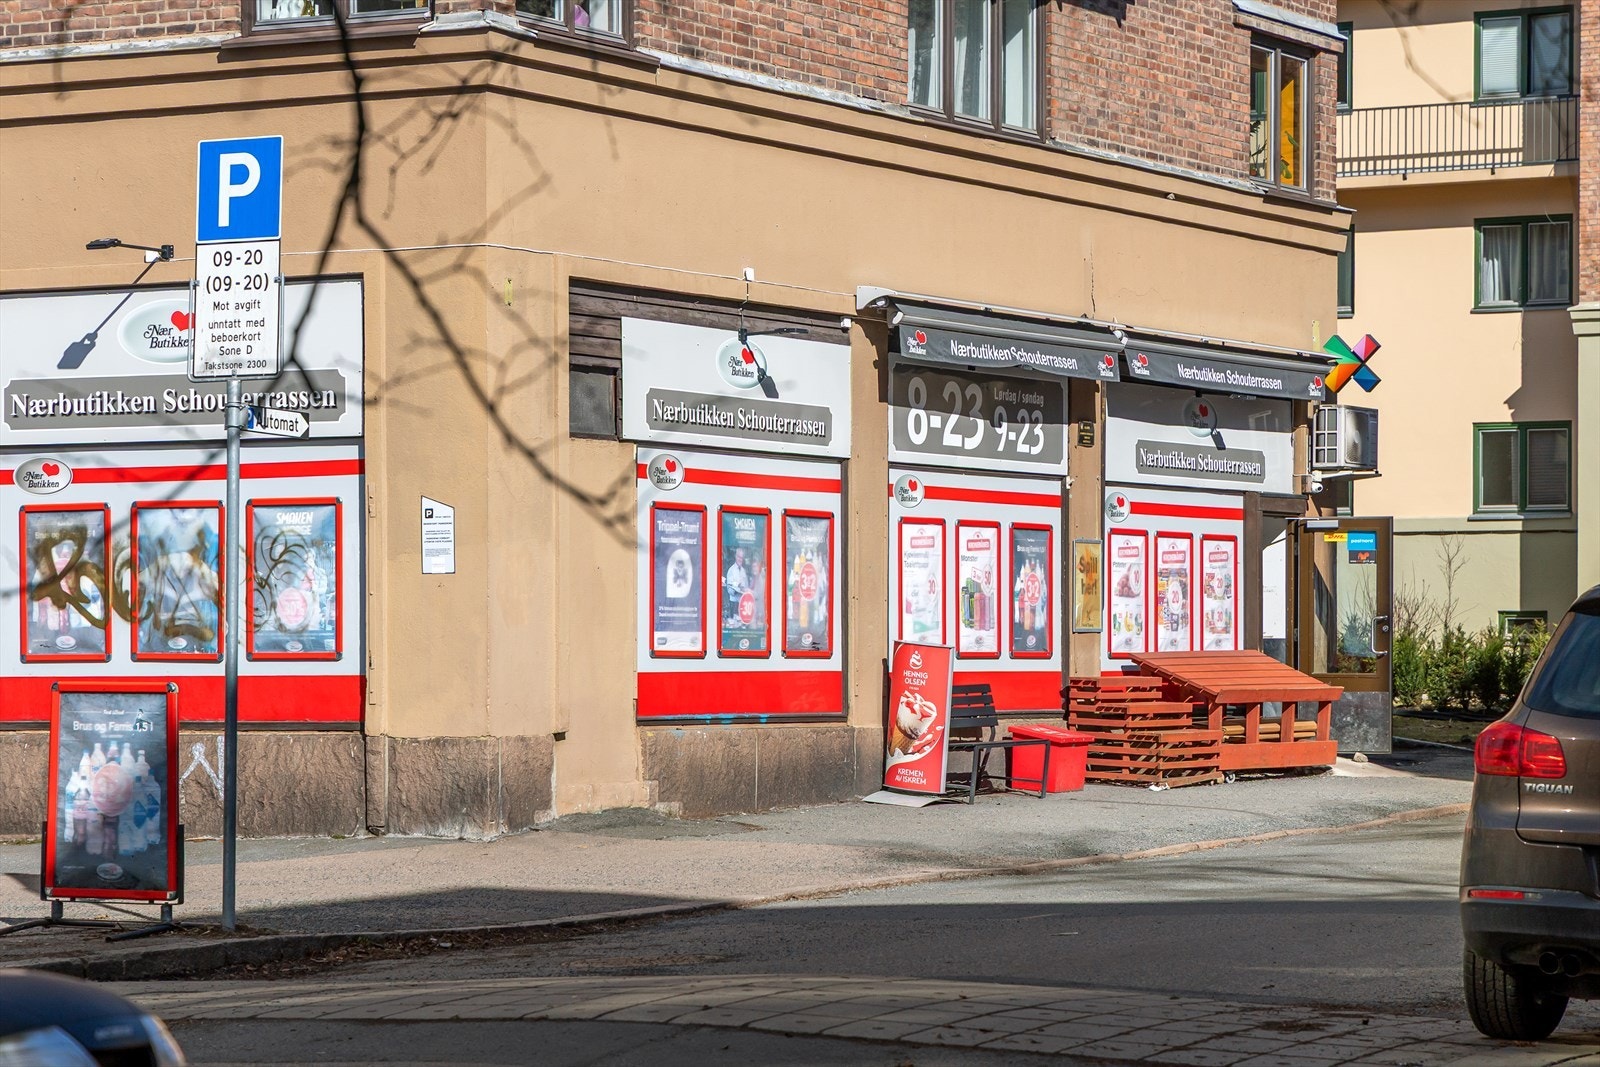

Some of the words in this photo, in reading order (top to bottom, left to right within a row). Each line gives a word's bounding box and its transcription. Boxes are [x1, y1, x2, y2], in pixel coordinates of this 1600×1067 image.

[218, 152, 261, 227] P
[213, 301, 230, 311] Mot
[234, 299, 261, 312] avgift
[208, 319, 241, 330] unntatt
[246, 317, 265, 328] med
[143, 324, 173, 339] Nær
[211, 332, 261, 343] beboerkort
[219, 345, 241, 355] Sone
[246, 344, 253, 354] D
[950, 339, 1012, 360] Nærbutikken
[1011, 346, 1079, 370] Schouterrassen
[204, 361, 243, 370] Takstsone
[247, 359, 267, 368] 2300
[728, 355, 743, 367] Nær
[731, 366, 755, 378] Butikken
[1177, 363, 1226, 383] Nærbutikken
[1226, 369, 1283, 390] Schouterrassen
[10, 388, 157, 418] Nærbutikken
[163, 386, 337, 413] Schouerrassen
[994, 387, 1017, 405] Lørdag
[1022, 392, 1044, 407] søndag
[652, 398, 735, 428] Nærbutikken
[737, 407, 827, 438] Schouterrassen
[907, 377, 984, 450] 8-23
[256, 413, 299, 433] Automat
[994, 405, 1044, 455] 9-23
[1139, 448, 1196, 471] Nærbutikken
[1198, 453, 1262, 477] Schouterrassen
[23, 471, 44, 481] Nær
[28, 480, 59, 488] Butikken
[275, 511, 314, 525] SMAKEN
[1079, 556, 1098, 578] Spill
[1081, 578, 1097, 595] her!
[903, 670, 928, 679] HENNIG
[904, 677, 926, 686] OLSEN
[73, 720, 92, 731] Brus
[94, 723, 107, 733] og
[897, 767, 924, 777] KREMEN
[902, 776, 927, 785] ISKREM
[1524, 783, 1574, 794] TIGUAN
